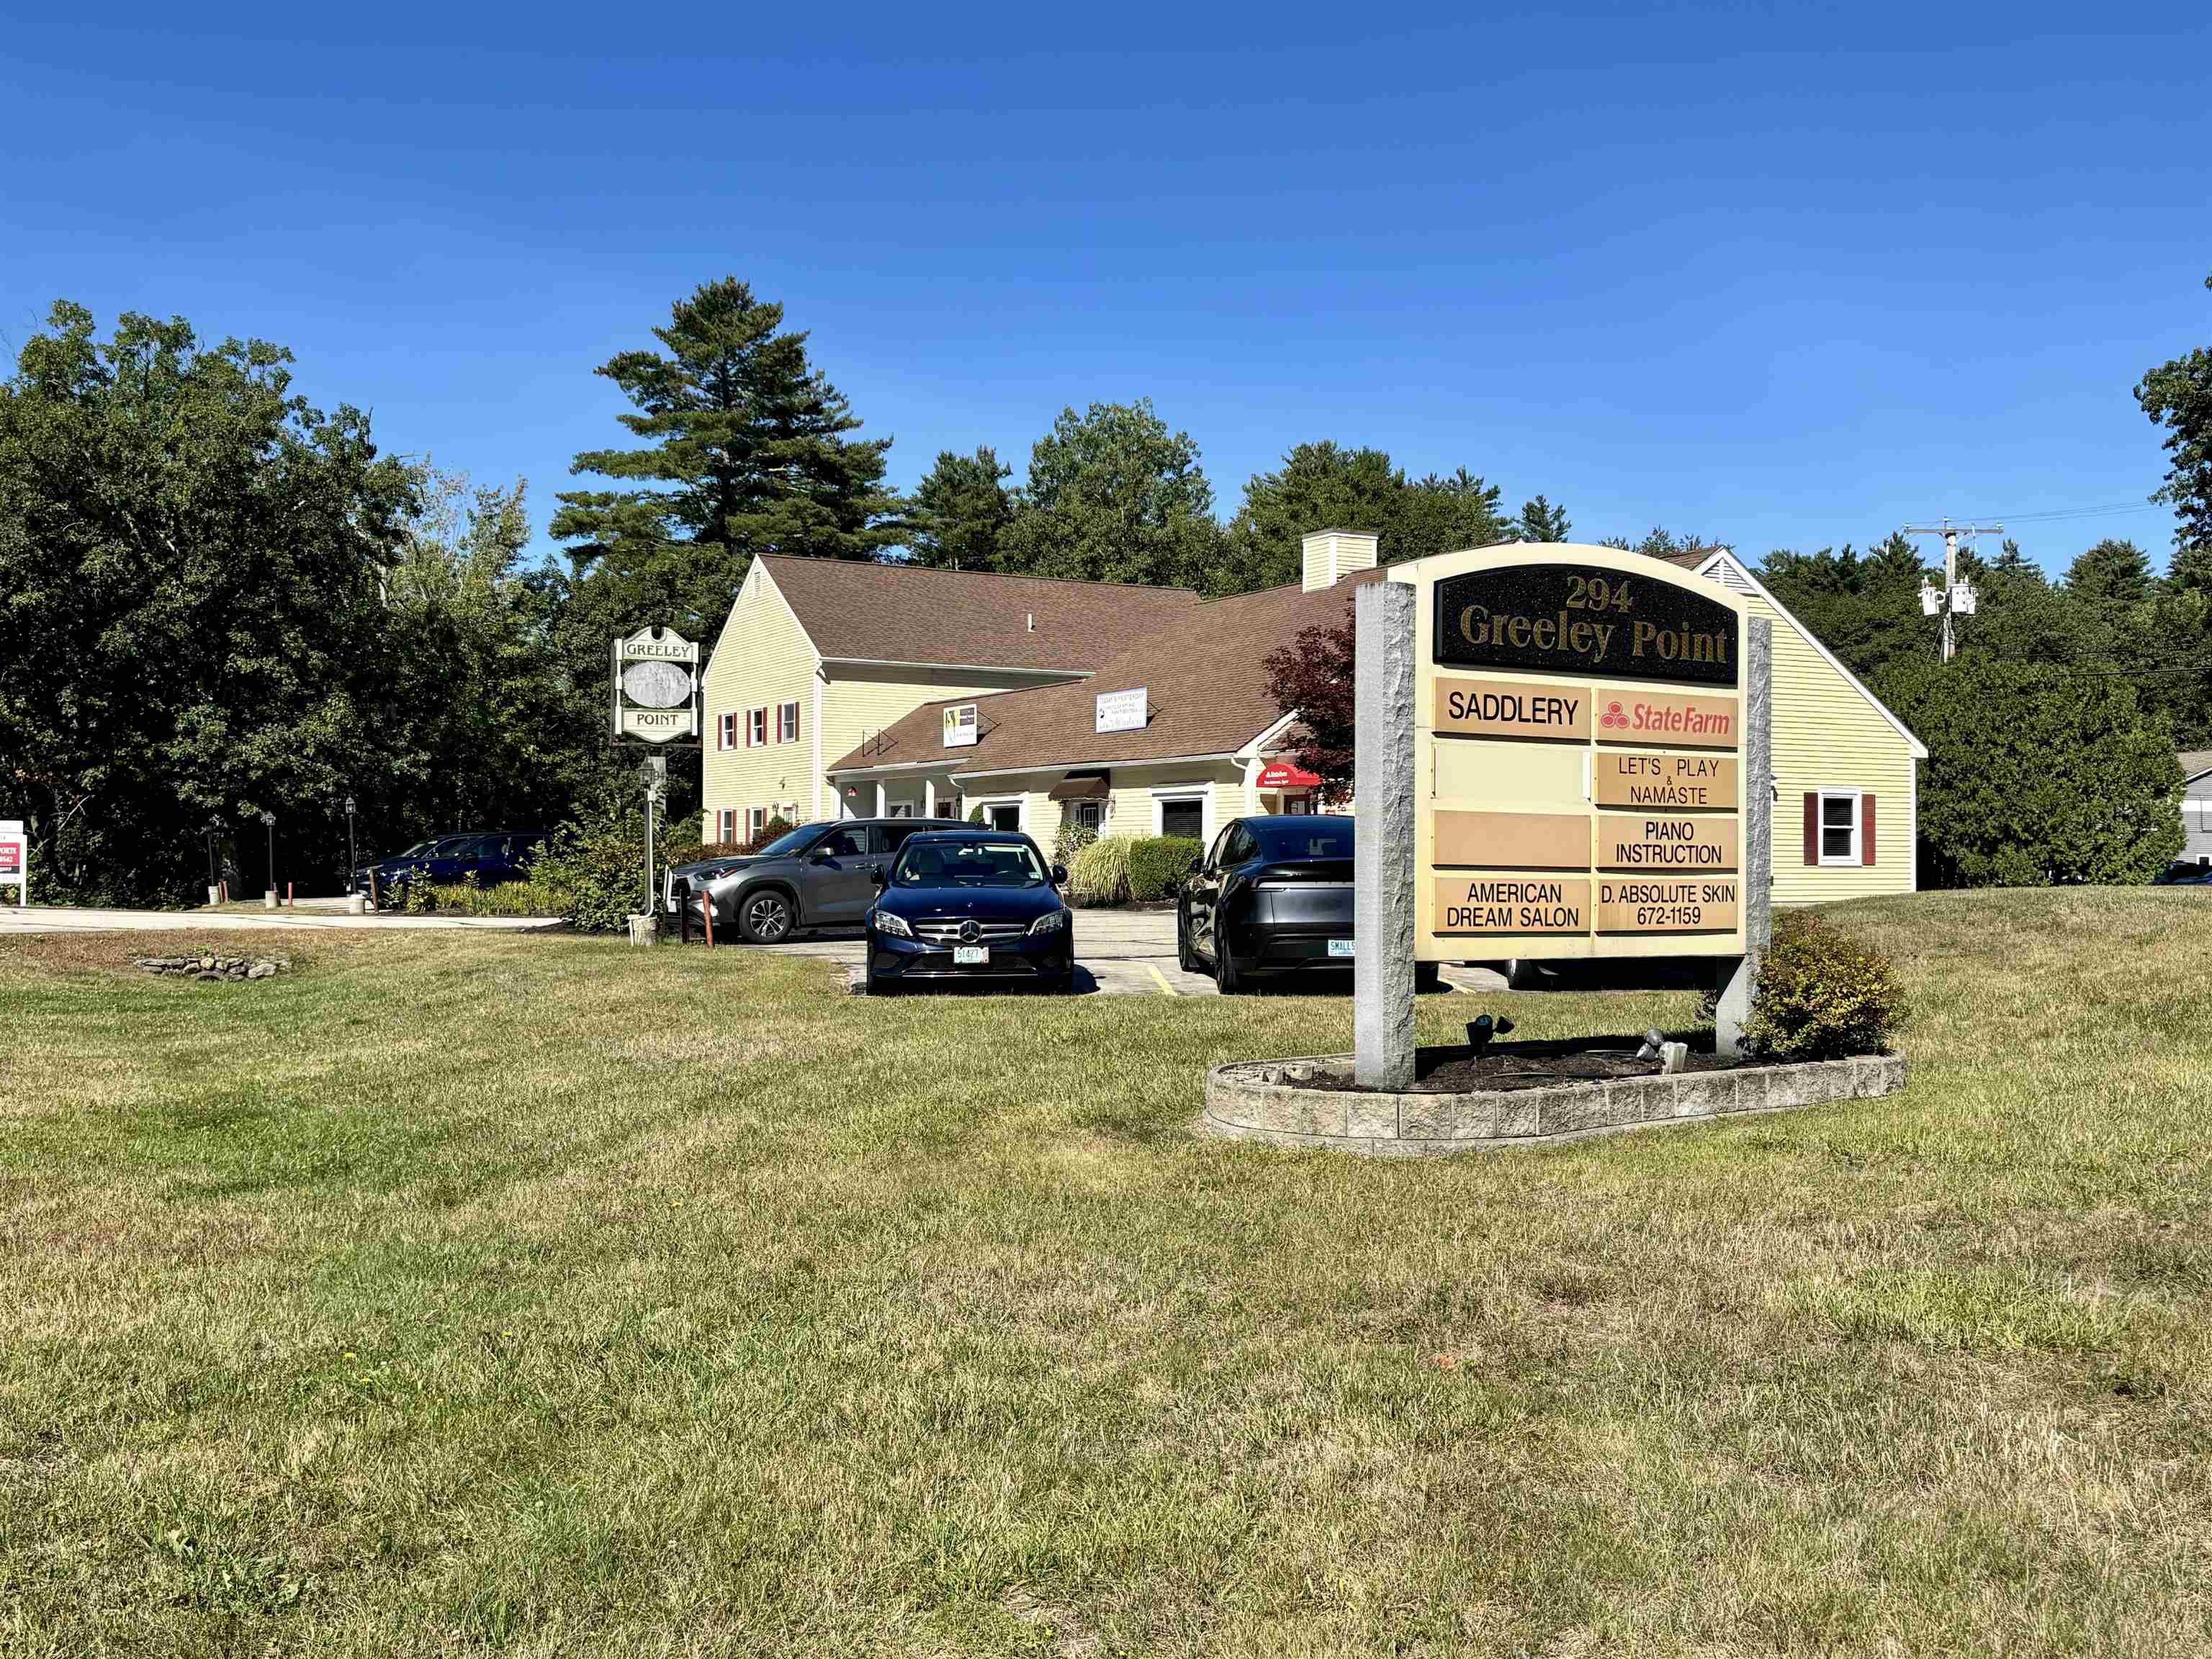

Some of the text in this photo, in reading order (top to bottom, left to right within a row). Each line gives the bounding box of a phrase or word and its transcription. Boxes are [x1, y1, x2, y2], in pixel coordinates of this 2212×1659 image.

[1566, 576, 1632, 613] 294
[1460, 604, 1727, 663] Greeley Point
[626, 644, 691, 657] GREELEY
[1449, 691, 1578, 725] SADDLERY
[637, 714, 679, 725] POINT
[1619, 757, 1719, 777] LET'S PLAY
[1666, 775, 1672, 786] &
[1630, 786, 1707, 804] NAMASTE
[1645, 822, 1694, 840] PIANO
[1616, 844, 1722, 863] INSTRUCTION
[1467, 883, 1562, 903] AMERICAN
[1601, 884, 1735, 903] D. ABSOLUTE SKIN
[1447, 907, 1579, 927] DREAM SALON
[1637, 907, 1701, 925] 672-1159
